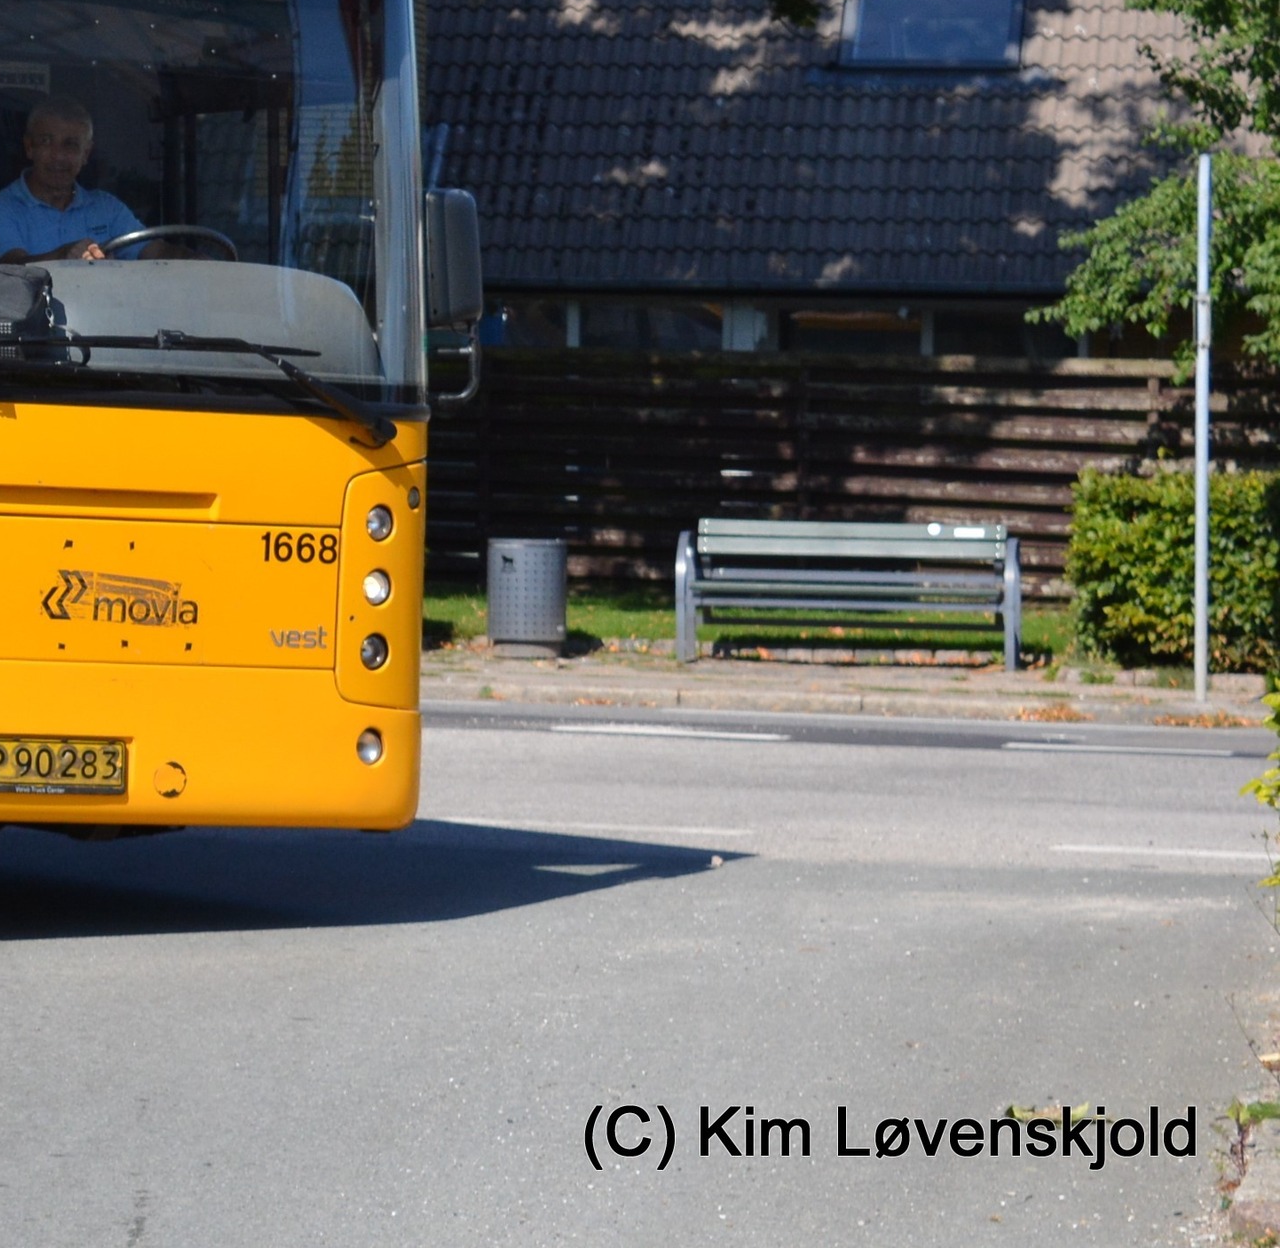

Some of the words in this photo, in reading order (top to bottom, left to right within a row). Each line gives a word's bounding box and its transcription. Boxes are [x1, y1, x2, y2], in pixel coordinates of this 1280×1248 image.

[261, 531, 338, 565] 1668
[92, 589, 199, 626] movia
[269, 625, 328, 650] vest
